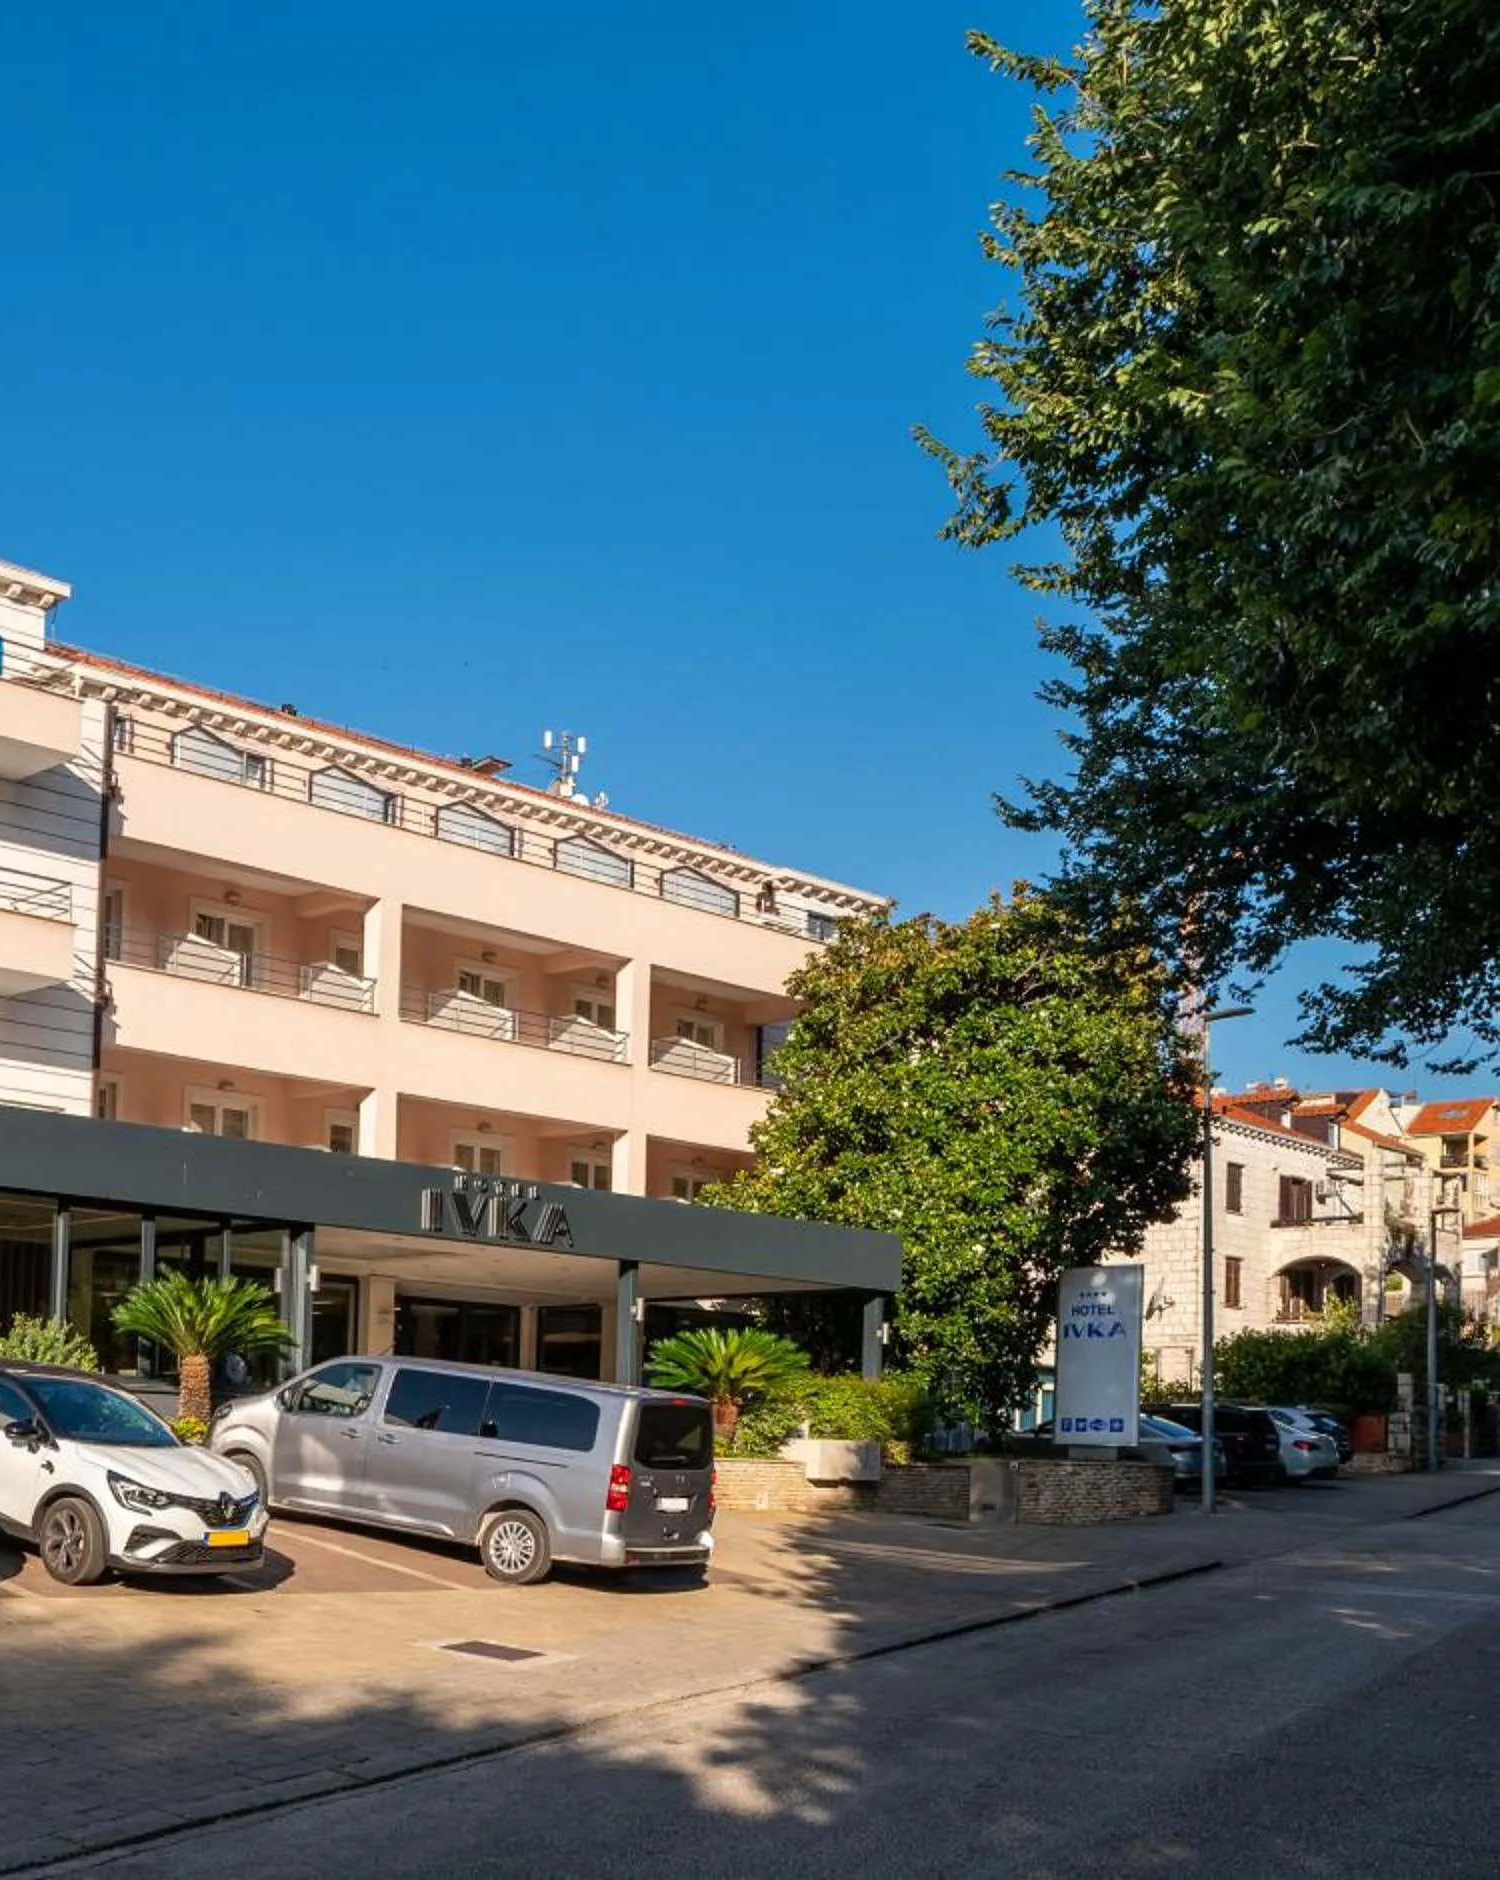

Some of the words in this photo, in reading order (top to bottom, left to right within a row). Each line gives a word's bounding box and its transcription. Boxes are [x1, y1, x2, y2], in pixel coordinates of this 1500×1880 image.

[421, 1187, 574, 1248] IVKA
[1071, 1303, 1115, 1317] HOTEL
[1063, 1322, 1127, 1339] IVKA
